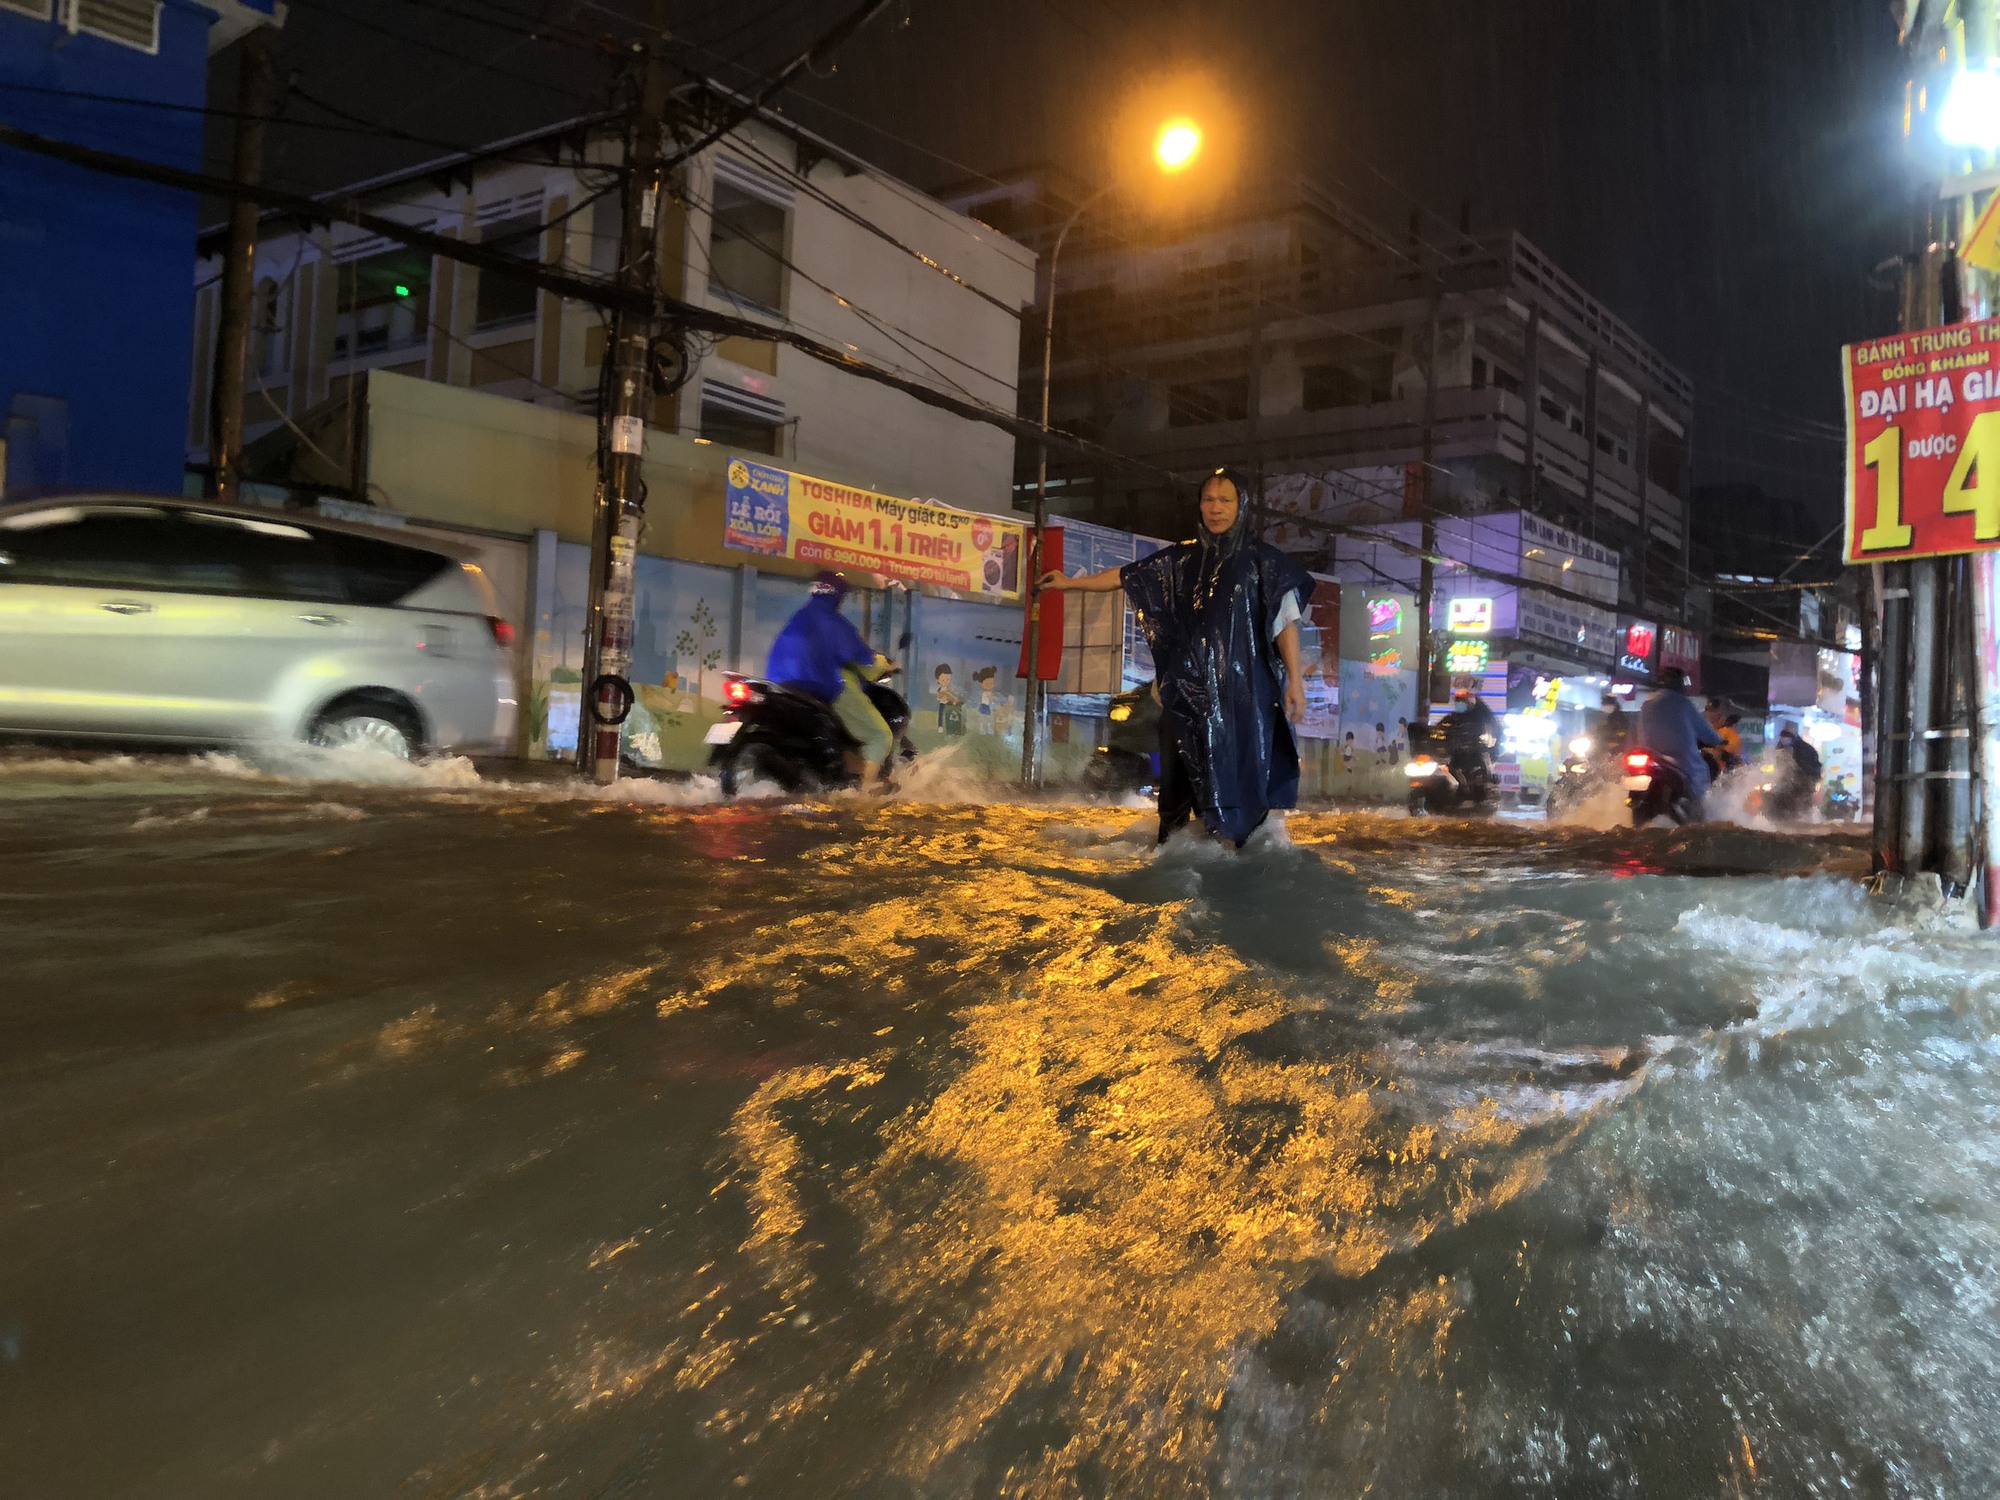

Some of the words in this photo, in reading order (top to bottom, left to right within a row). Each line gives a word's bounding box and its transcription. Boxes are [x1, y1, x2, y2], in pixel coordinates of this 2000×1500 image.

[1857, 339, 1905, 366] BÁNH
[1910, 327, 1972, 354] TRUNG
[1860, 384, 1907, 422] ĐẠI
[1915, 376, 1955, 414] HẠ
[751, 478, 786, 497] XANH
[800, 480, 874, 511] TOSHIBA
[876, 498, 907, 521] Máy
[908, 506, 935, 526] giặt
[1861, 425, 1913, 551] 1
[1909, 433, 1957, 460] ĐƯỢC
[1943, 410, 2000, 541] 4
[800, 543, 822, 559] còn
[823, 547, 880, 570] 6.990.000
[808, 508, 865, 545] GIẢM
[868, 518, 904, 555] 1.1
[907, 532, 962, 567] TRIỆU
